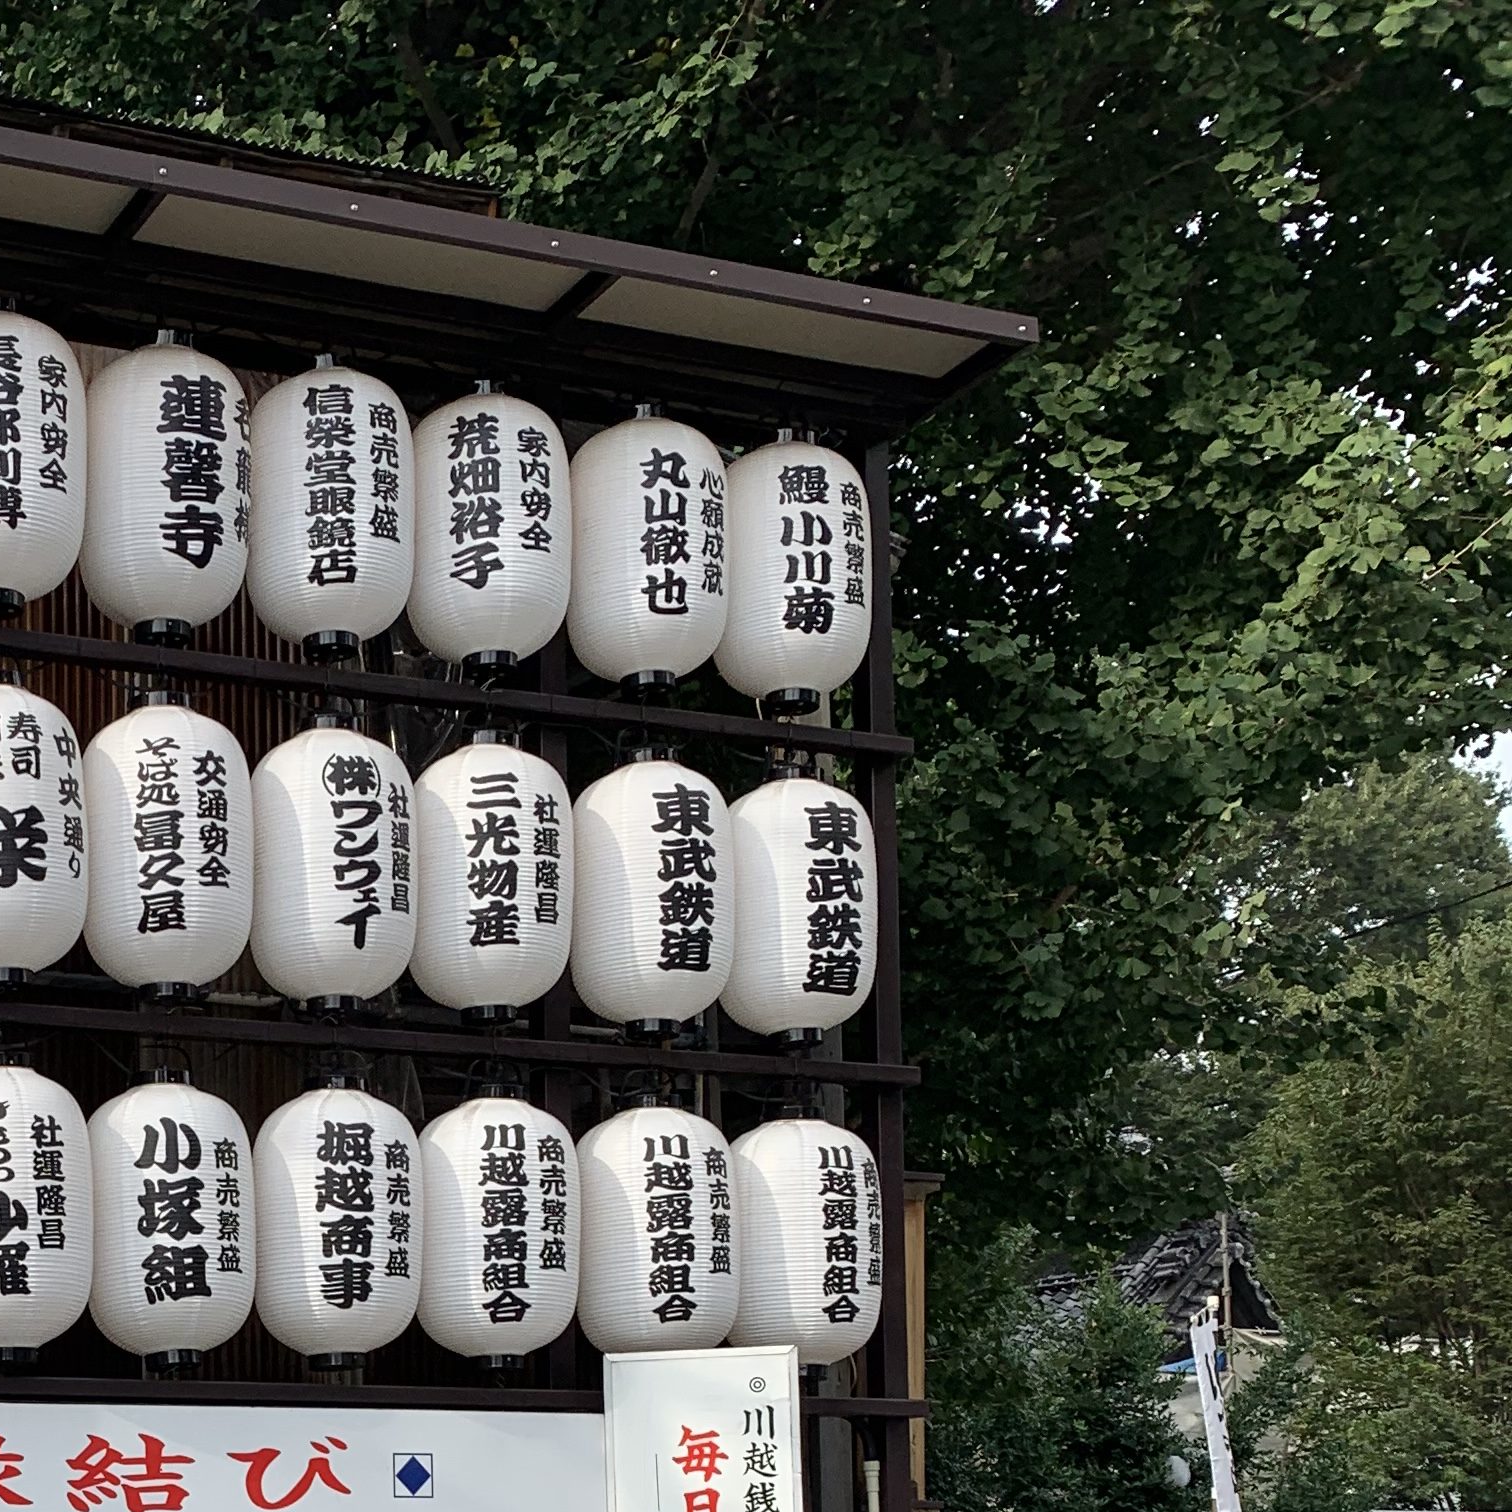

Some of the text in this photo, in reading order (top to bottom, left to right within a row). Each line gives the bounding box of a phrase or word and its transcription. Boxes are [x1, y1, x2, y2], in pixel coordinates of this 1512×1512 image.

[37, 354, 68, 494] 家内安全
[368, 402, 400, 543] 商売繁盛
[517, 426, 552, 553] 家内安全
[448, 413, 505, 590] 荒畑裕子
[640, 447, 691, 615] 丸山徹也
[699, 467, 724, 597] 心願成就
[778, 464, 835, 635] 鰻小川菊
[840, 481, 866, 609] 商売繁盛
[6, 711, 43, 780] 寿司
[53, 727, 85, 879] 中央通り
[192, 750, 231, 888] 交通安全
[465, 771, 522, 947] 三光物産
[651, 783, 717, 972] 東武鉄道
[801, 801, 865, 997] 東武鉄道
[30, 1114, 67, 1250] 社運隆昌
[134, 1116, 212, 1305] 小塚組
[212, 1137, 243, 1274] 商売繁盛
[383, 1139, 411, 1280] 商売繁盛
[478, 1123, 532, 1324] 川越露商組合
[537, 1134, 567, 1272] 商売繁盛
[643, 1133, 698, 1324] 川越露商組合
[702, 1146, 732, 1276] 商売繁盛
[818, 1144, 861, 1324] 川越露商組合
